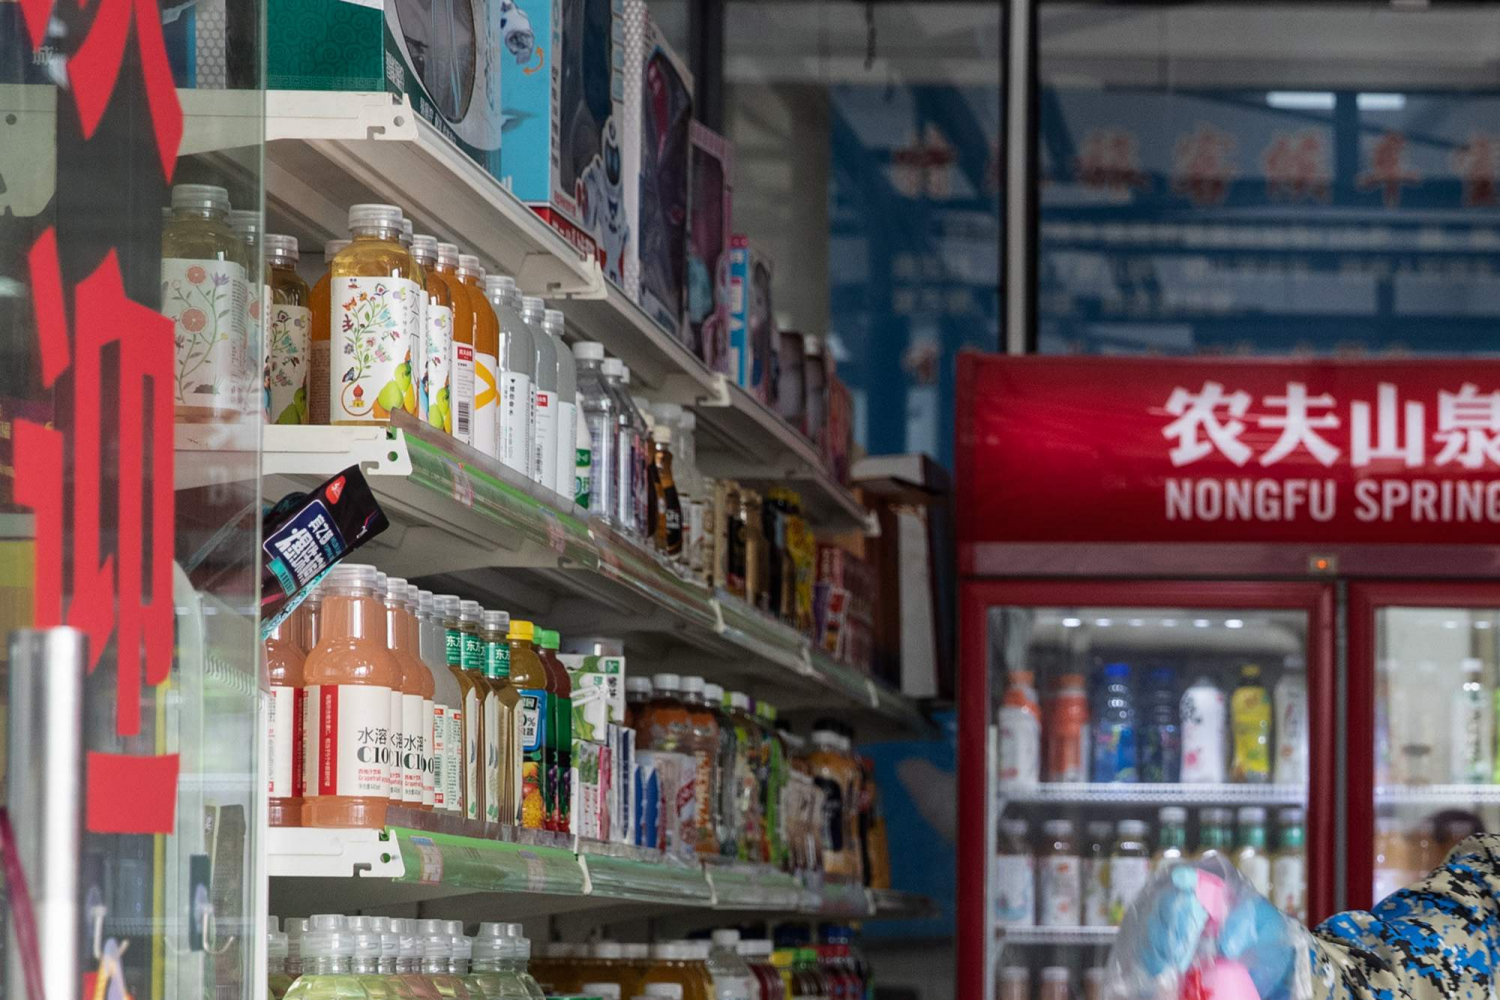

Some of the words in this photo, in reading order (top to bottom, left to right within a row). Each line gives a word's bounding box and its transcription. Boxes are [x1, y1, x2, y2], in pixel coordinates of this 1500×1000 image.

[1165, 477, 1337, 522] NONGFU
[357, 726, 387, 745] 水溶
[356, 746, 389, 765] C10
